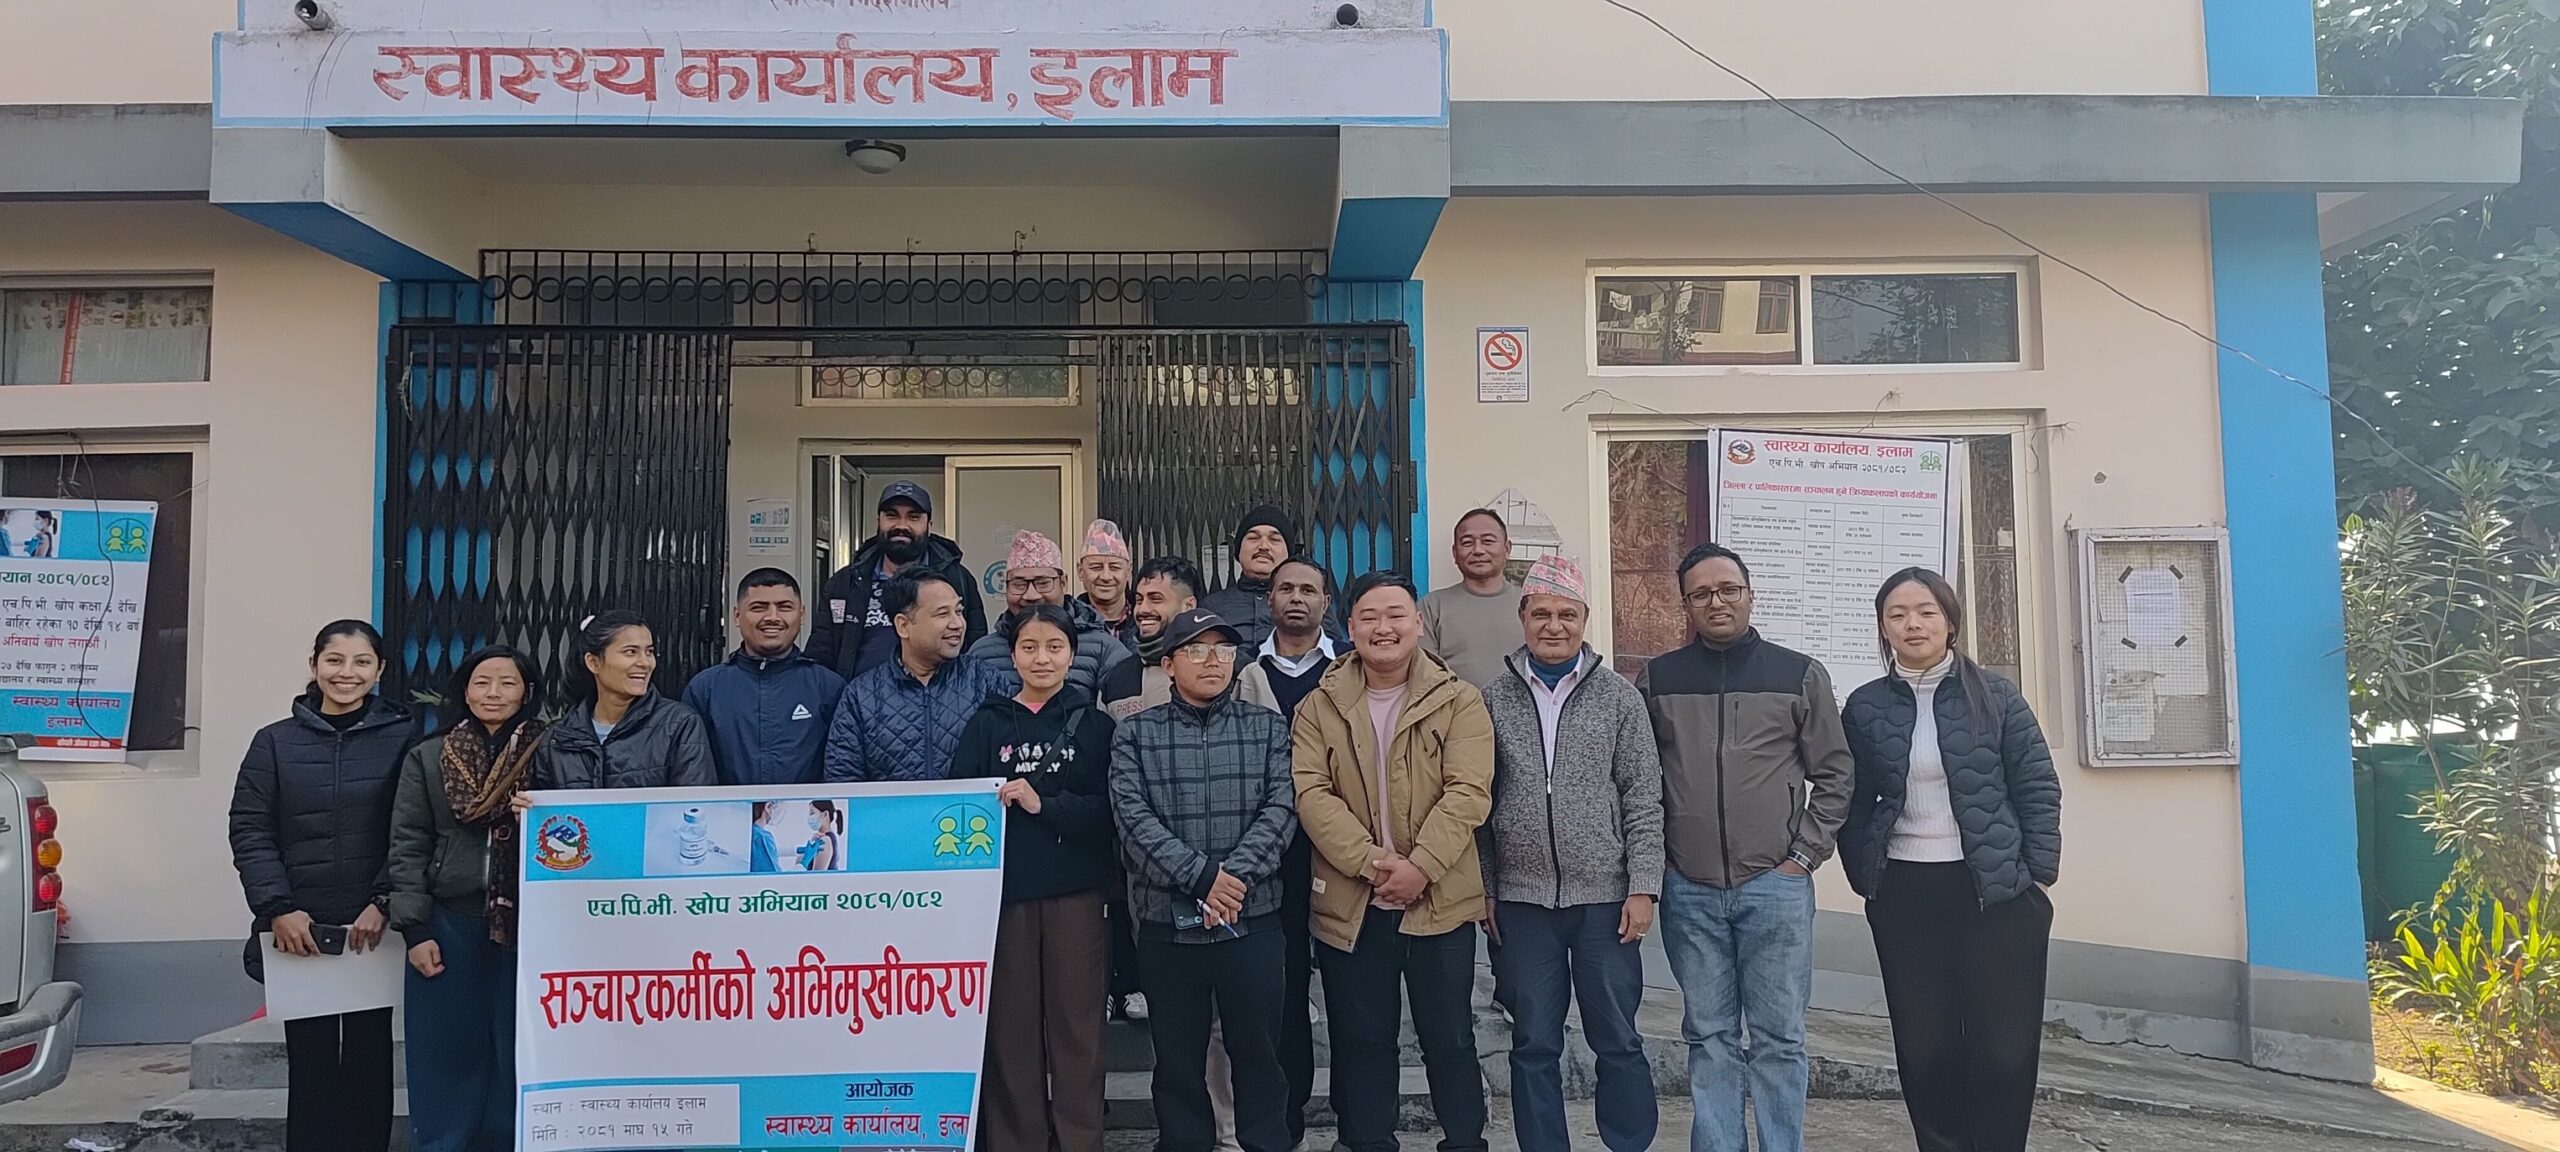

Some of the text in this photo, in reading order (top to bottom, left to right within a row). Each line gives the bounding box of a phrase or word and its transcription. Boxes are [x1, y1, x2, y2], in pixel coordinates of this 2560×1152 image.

[373, 46, 664, 102] स्वास्थ्य
[1030, 48, 1238, 121] इलाम
[1764, 439, 1809, 453] स्वास्थ्य
[1876, 445, 1915, 458] इलाम
[1810, 460, 1825, 469] खोप
[1828, 460, 1858, 471] अभियान
[37, 573, 110, 586] २०८१/०८२
[55, 598, 75, 611] खोप
[79, 602, 102, 612] कक्षा
[118, 599, 137, 614] देखि
[36, 616, 62, 630] रहेका
[67, 620, 78, 630] १०
[44, 635, 64, 648] खोप
[1015, 762, 1061, 773] MICY
[587, 889, 943, 916] एच.पि.भी. खोप अभियान २०८१/०८२
[540, 945, 987, 1034] सञ्चारकर्मीको अभिमुखीकरण
[845, 1079, 914, 1098] आयोजक
[532, 1102, 562, 1115] स्थान
[581, 1099, 620, 1112] स्वास्थ्य
[627, 1094, 671, 1110] कार्यालय
[677, 1097, 706, 1110] इलाम
[532, 1124, 558, 1143] मिति
[577, 1124, 615, 1137] २०८१
[623, 1123, 645, 1136] माघ
[652, 1122, 669, 1137] १५
[676, 1119, 693, 1136] गते
[764, 1115, 833, 1136] स्वास्थ्य
[938, 1114, 970, 1137] इला
